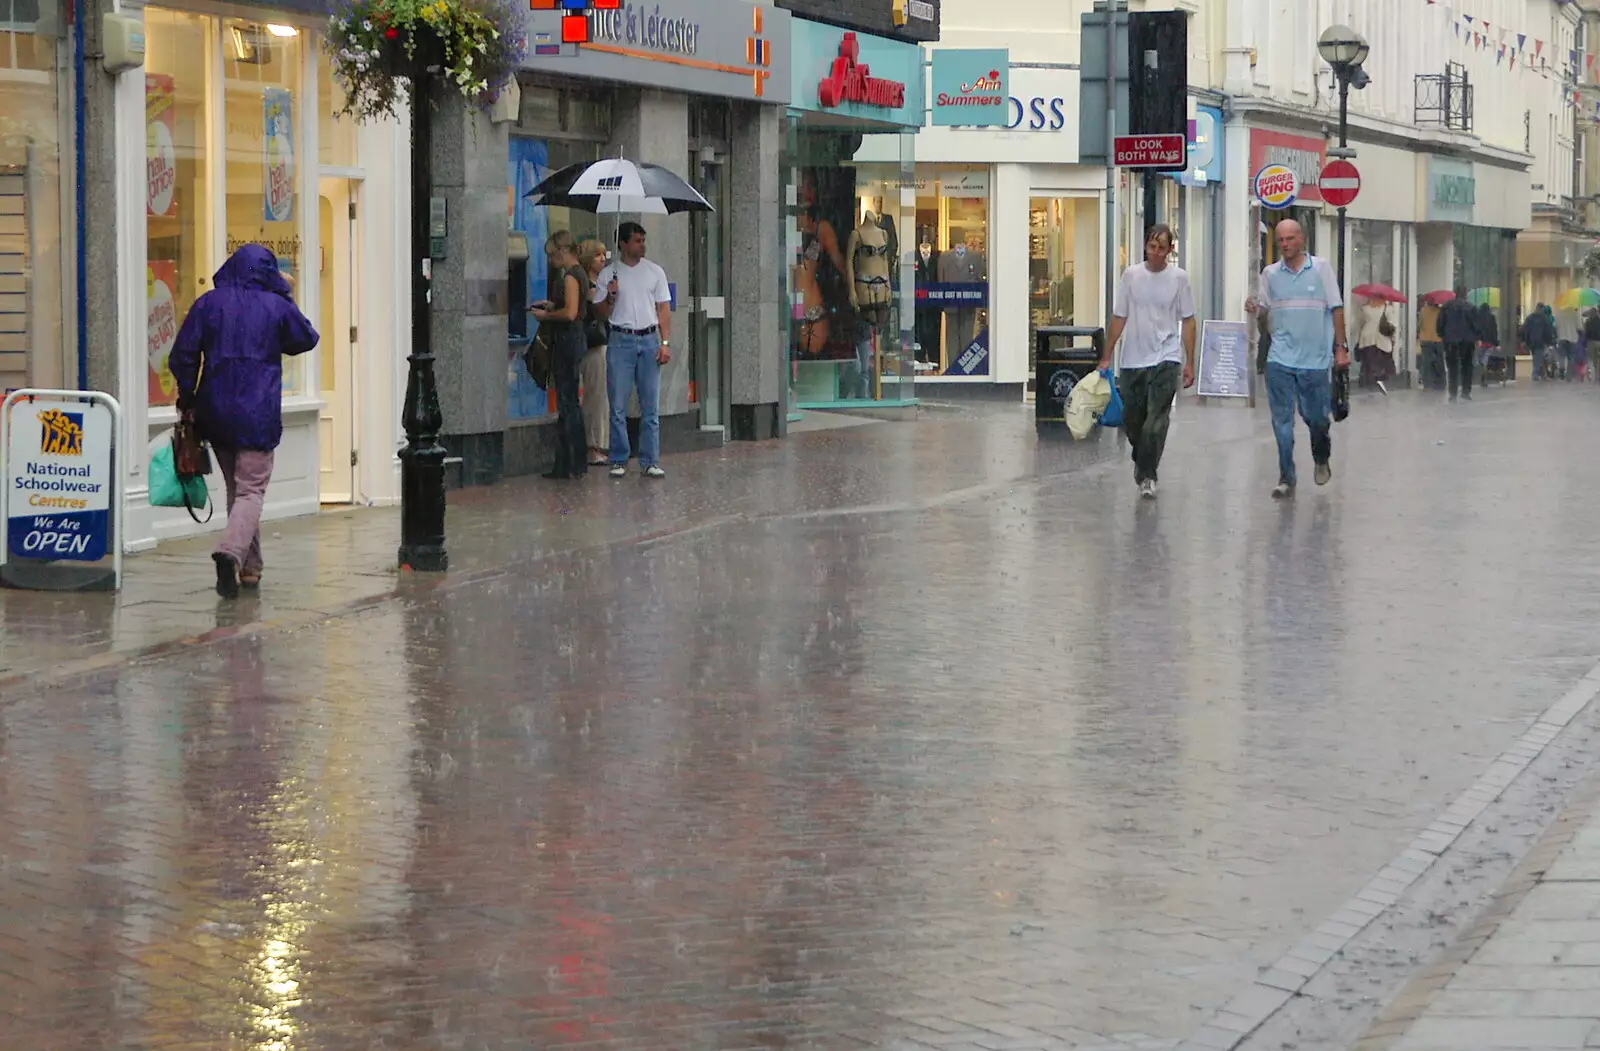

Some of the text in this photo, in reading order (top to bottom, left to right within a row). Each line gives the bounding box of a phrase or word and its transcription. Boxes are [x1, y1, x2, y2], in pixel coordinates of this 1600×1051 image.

[626, 3, 637, 44] &
[640, 4, 699, 55] Leicester
[854, 63, 905, 109] Summers
[960, 77, 1002, 94] Ann
[936, 93, 1002, 107] Summers
[1134, 139, 1163, 150] LOOK
[1117, 150, 1180, 161] BOTH WAYS
[147, 168, 174, 206] price
[1258, 173, 1293, 187] BURGER
[1259, 181, 1294, 198] KING
[26, 461, 91, 478] National
[15, 477, 102, 494] Schoolwear
[28, 494, 88, 509] Centres
[34, 516, 81, 531] We Are
[23, 531, 92, 554] OPEN
